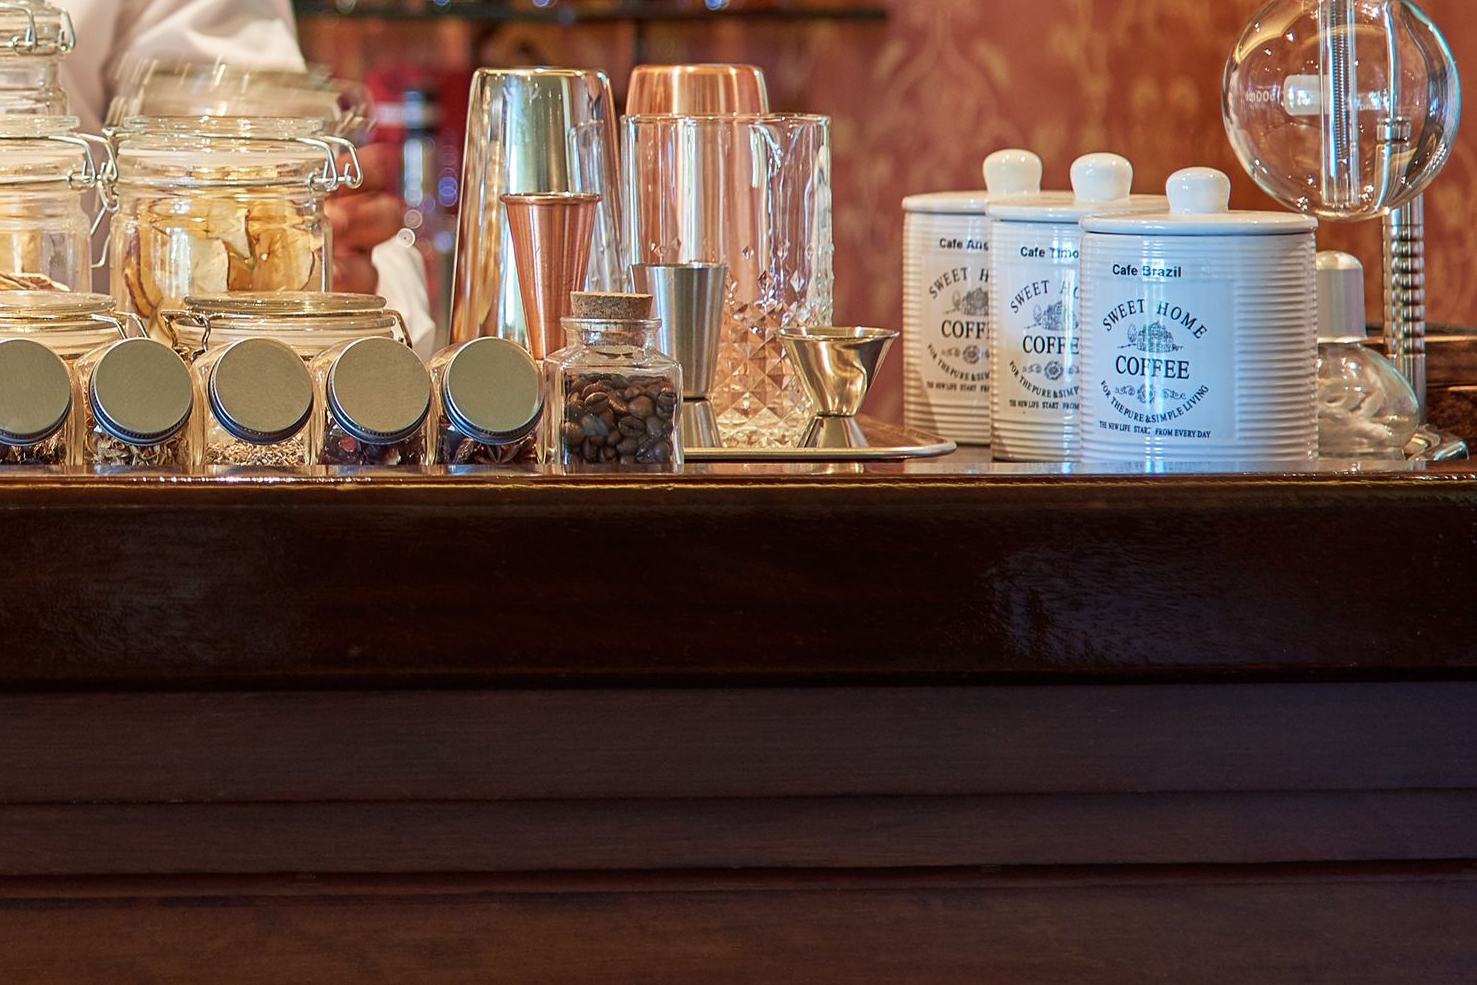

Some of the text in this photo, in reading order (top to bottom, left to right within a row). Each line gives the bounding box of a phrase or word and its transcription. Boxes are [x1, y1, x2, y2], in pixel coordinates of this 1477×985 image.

[939, 237, 963, 250] Cafe
[1020, 246, 1046, 258] Cafe
[929, 266, 968, 300] SWEET
[1112, 264, 1182, 278] Cafe Brazil
[1010, 279, 1050, 314] SWEET
[941, 319, 990, 340] COFF
[1102, 298, 1208, 340] SWEET HOME
[1008, 360, 1020, 378] FOR
[1019, 374, 1032, 391] THE
[1115, 355, 1190, 380] COFFEE
[1100, 380, 1112, 399] FOR
[1110, 396, 1124, 413] THE
[1123, 407, 1144, 423] PURE
[1182, 384, 1209, 411] LIVING
[1099, 420, 1108, 429] THE
[1108, 422, 1119, 430] NEW
[1119, 423, 1131, 432] LIFE
[1155, 427, 1173, 436] FROM
[1174, 428, 1197, 438] EVERY
[1197, 430, 1211, 438] DAY
